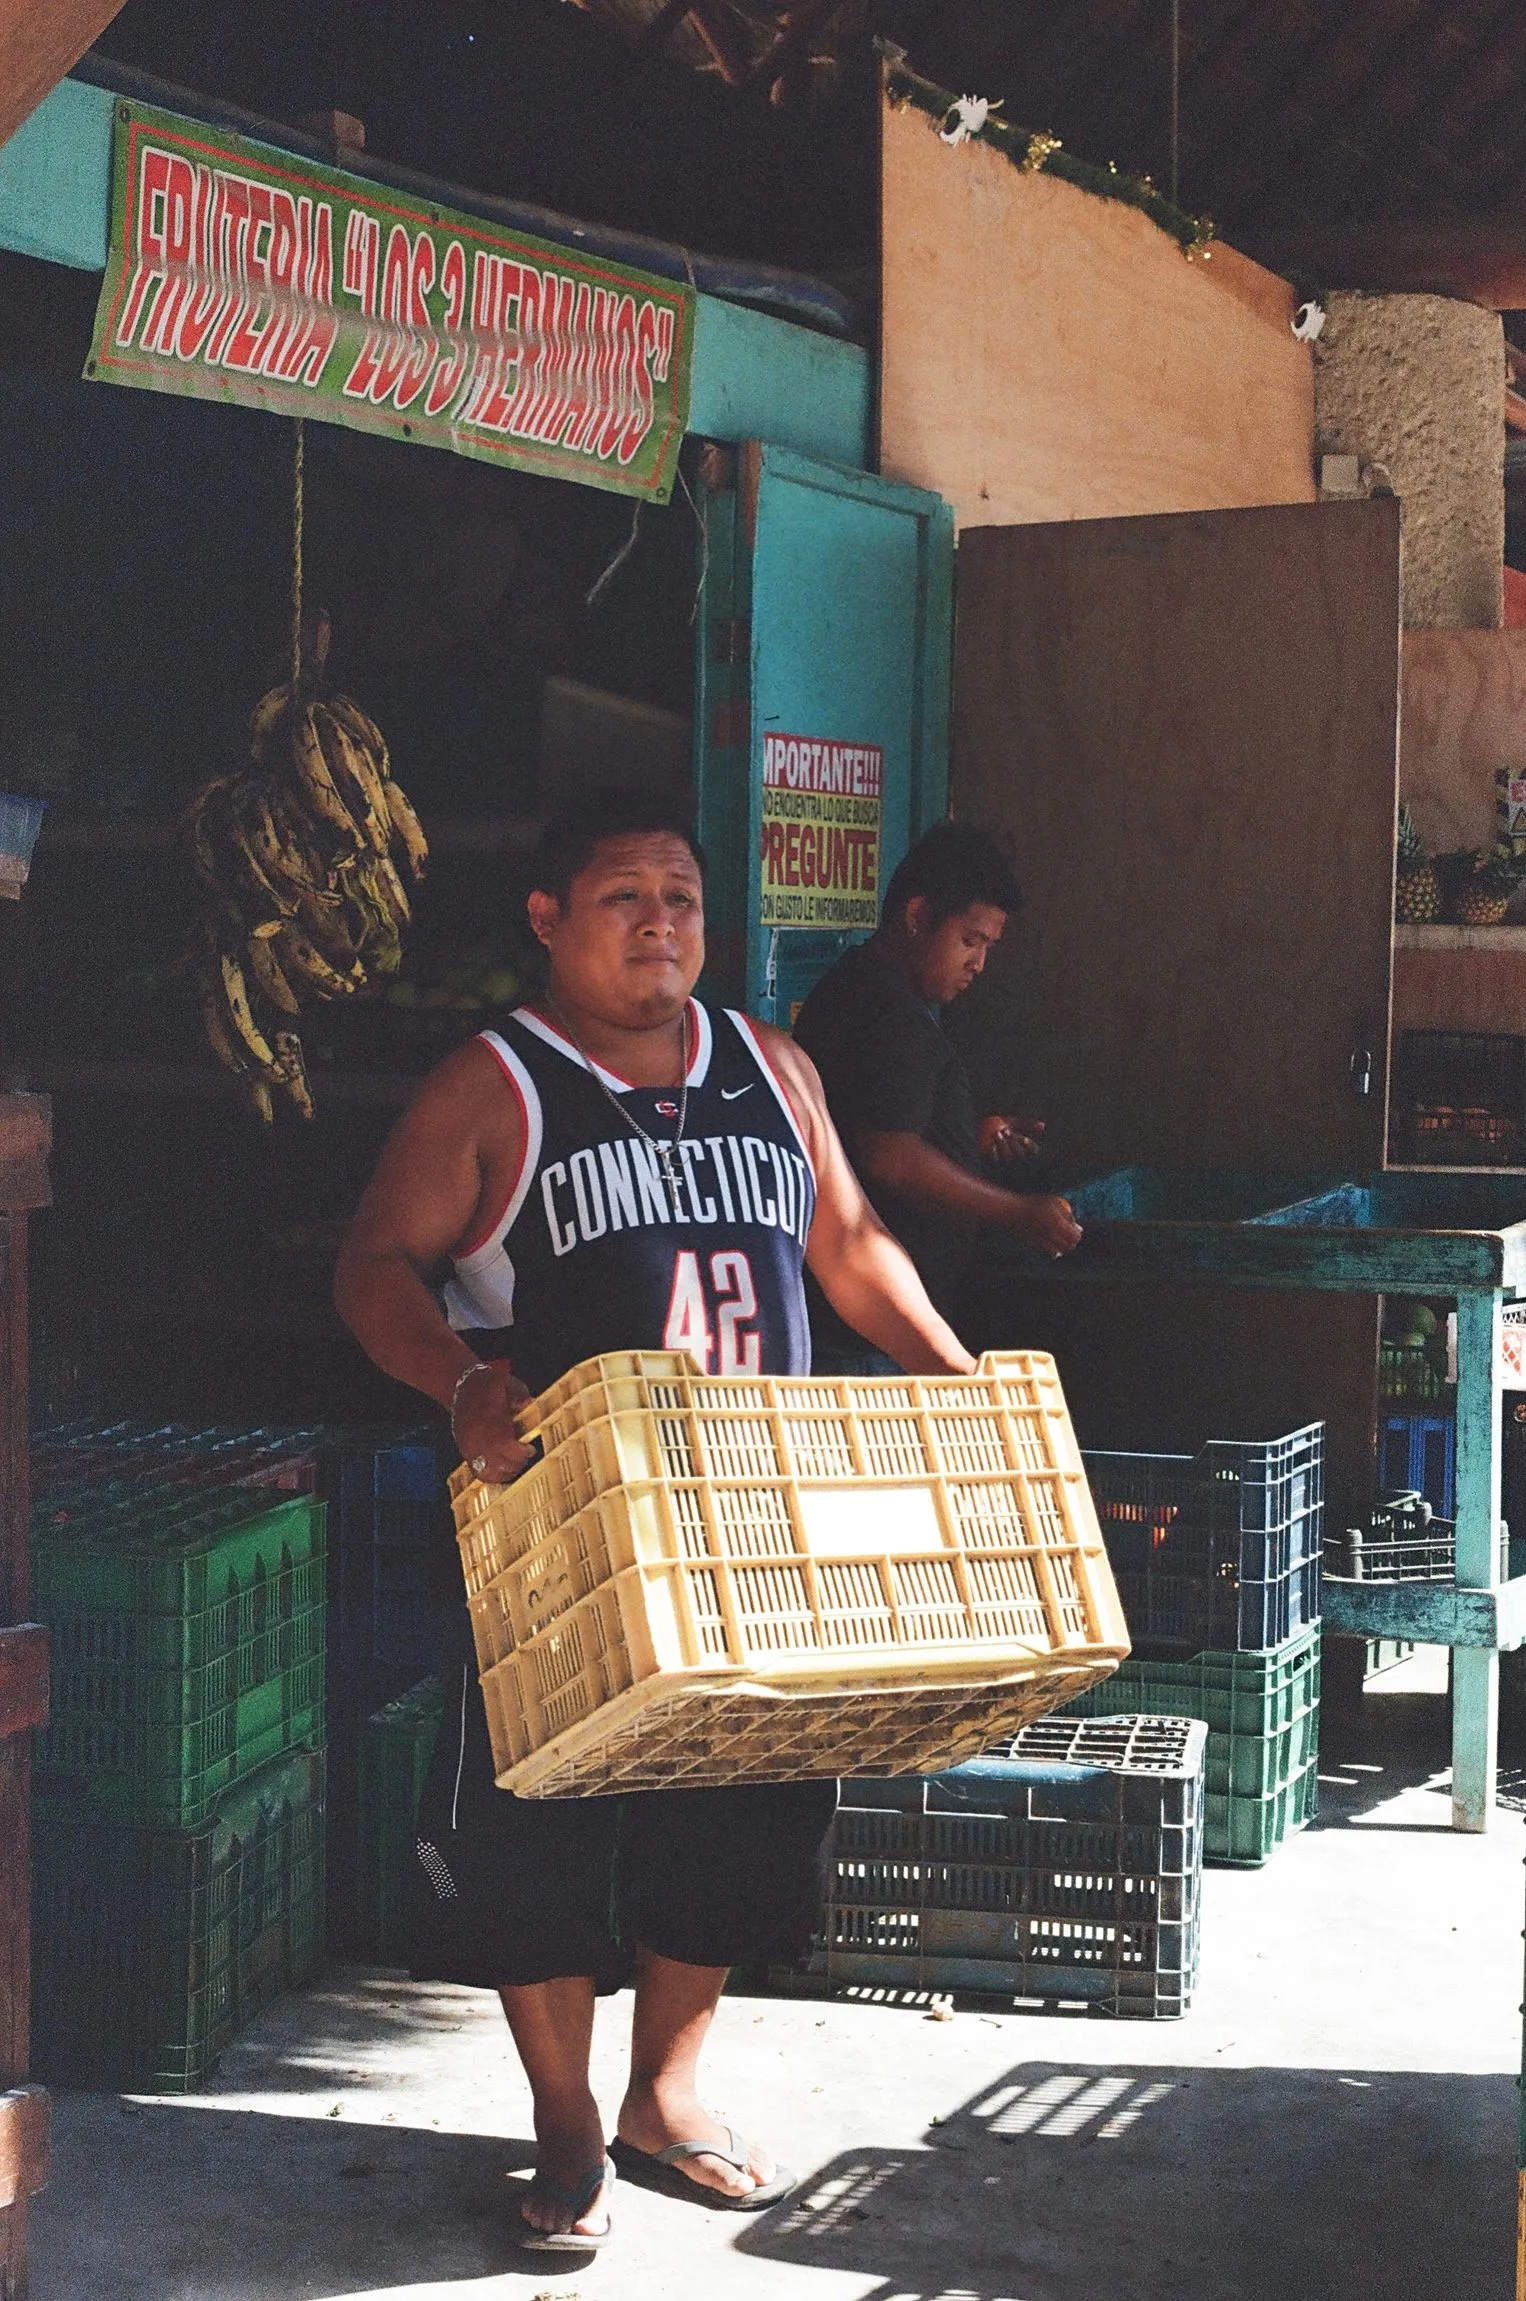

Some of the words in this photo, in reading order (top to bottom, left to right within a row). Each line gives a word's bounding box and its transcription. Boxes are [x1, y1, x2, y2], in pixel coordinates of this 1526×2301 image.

[425, 241, 467, 416] 3
[774, 791, 821, 820] ENCUENTRA
[836, 797, 852, 823] QUE
[776, 894, 803, 920] GUSTO
[804, 896, 814, 921] LE
[541, 1135, 805, 1257] CONNECTICUT
[663, 1249, 763, 1376] 42
